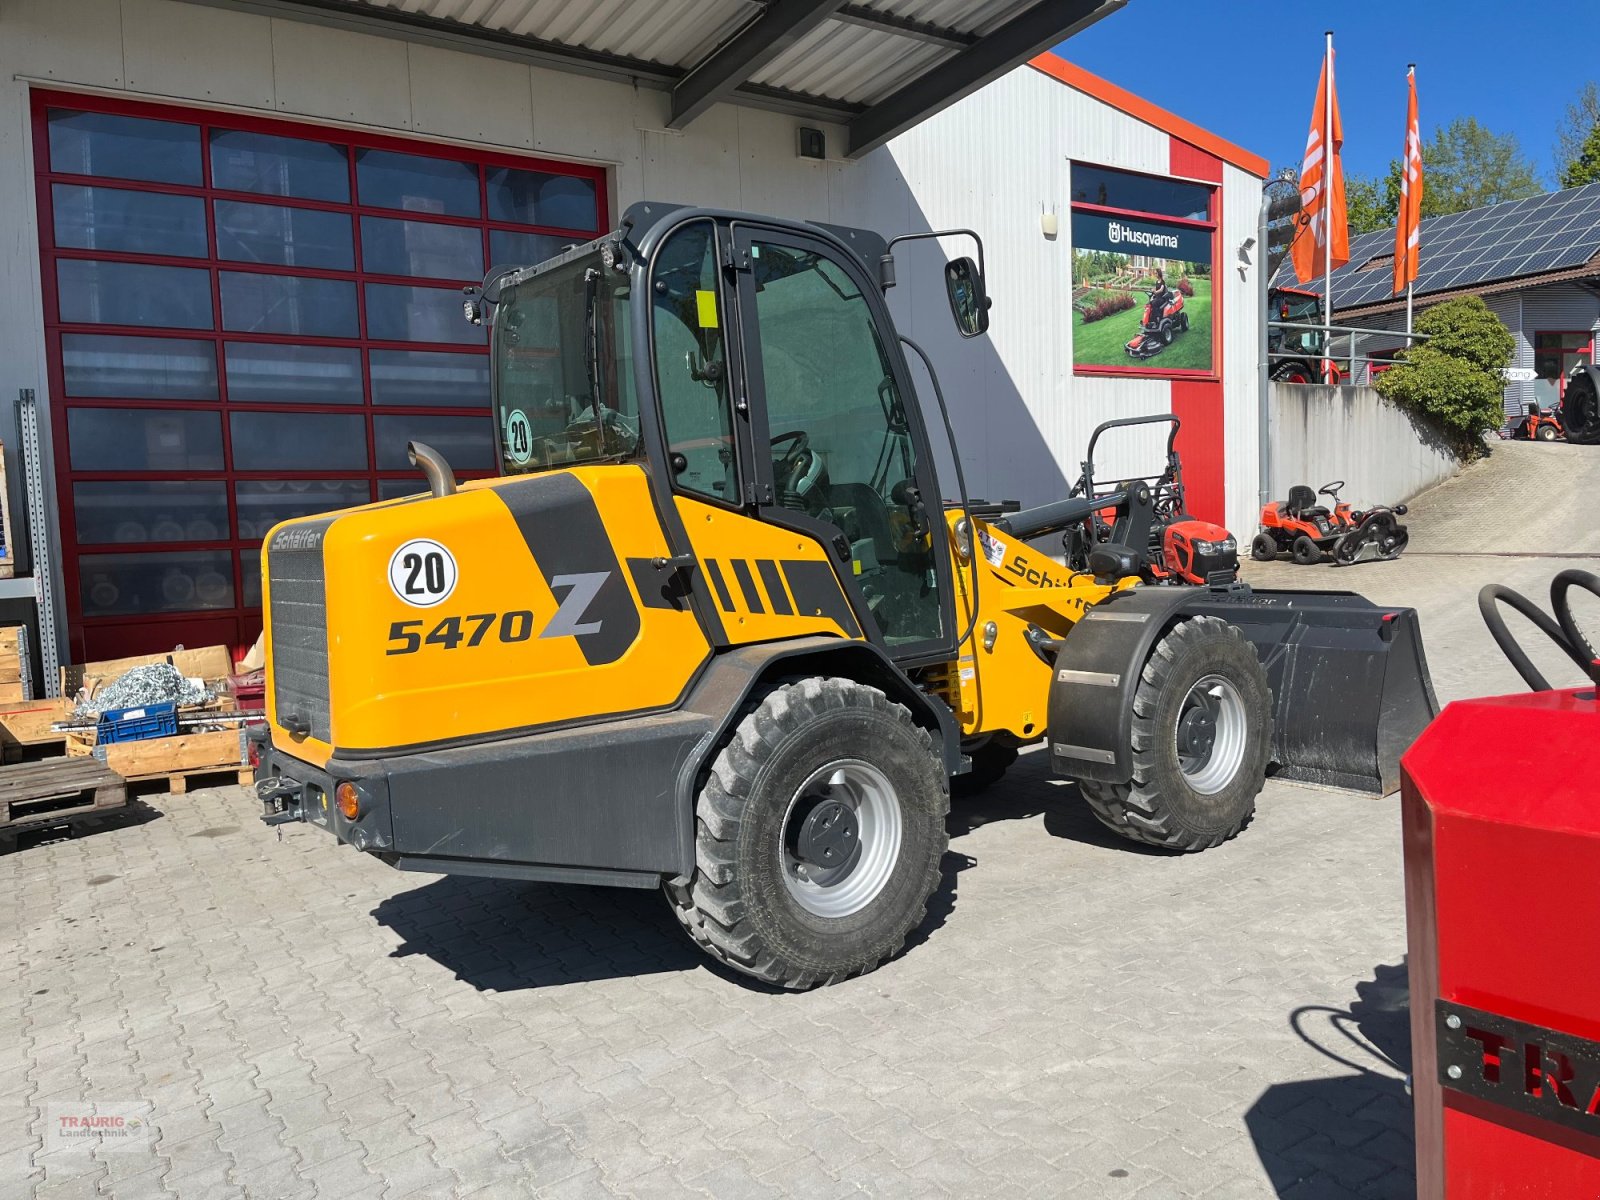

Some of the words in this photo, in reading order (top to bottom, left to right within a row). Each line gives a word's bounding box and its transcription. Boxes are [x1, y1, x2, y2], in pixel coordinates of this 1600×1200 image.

[1121, 226, 1178, 248] Husqvarna
[511, 420, 528, 454] 20
[272, 529, 321, 550] Schäffer
[403, 551, 445, 595] 20
[386, 610, 534, 656] 5470
[537, 571, 611, 639] Z
[1465, 1026, 1600, 1116] TR
